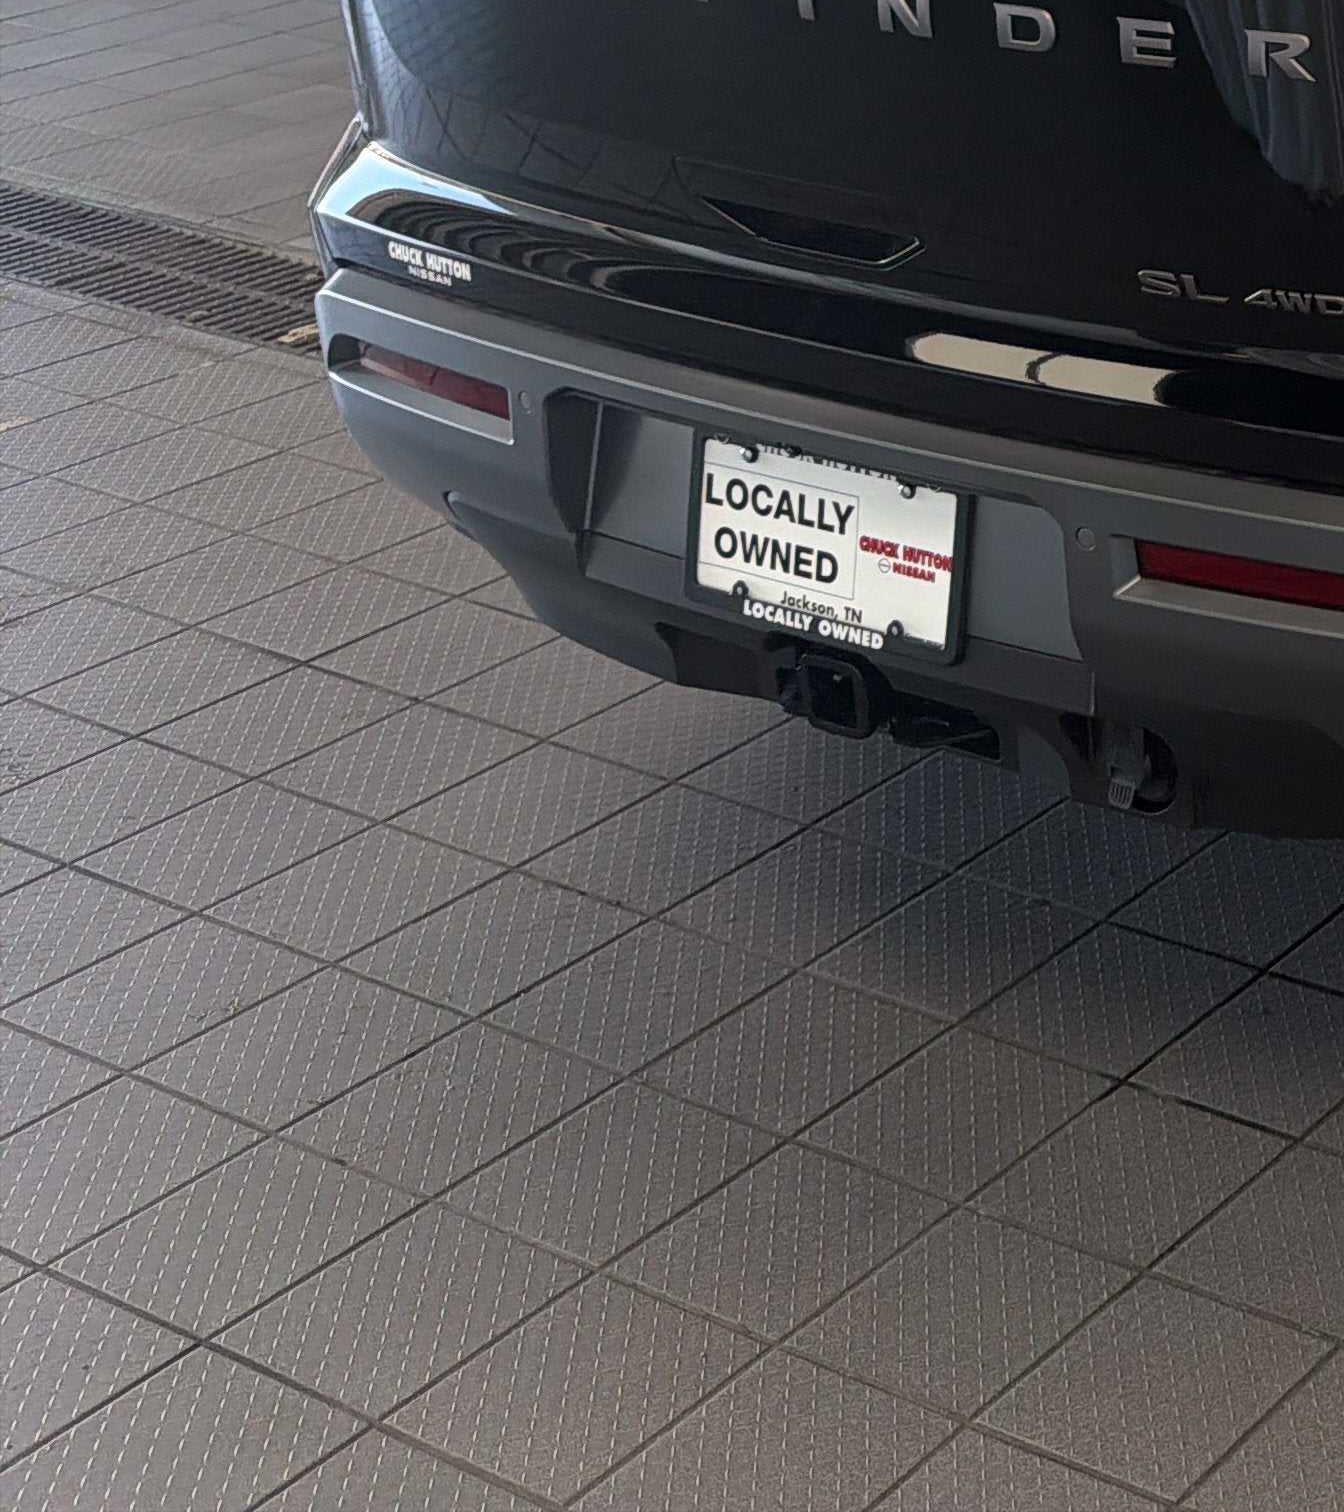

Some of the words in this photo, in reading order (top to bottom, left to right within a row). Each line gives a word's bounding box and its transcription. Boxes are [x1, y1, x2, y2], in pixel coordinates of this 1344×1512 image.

[389, 241, 423, 265] CHUCK
[427, 252, 471, 281] HUTTON
[409, 266, 452, 286] NISSAN
[1137, 269, 1229, 304] SL
[705, 472, 855, 536] LOCALLY
[714, 527, 839, 584] OWNED
[859, 535, 900, 559] CHUCK
[892, 562, 936, 583] NISSAN
[780, 591, 838, 620] Jackson,
[844, 607, 863, 623] TN
[743, 600, 814, 633] LOCALLY
[818, 621, 884, 650] OWNED
